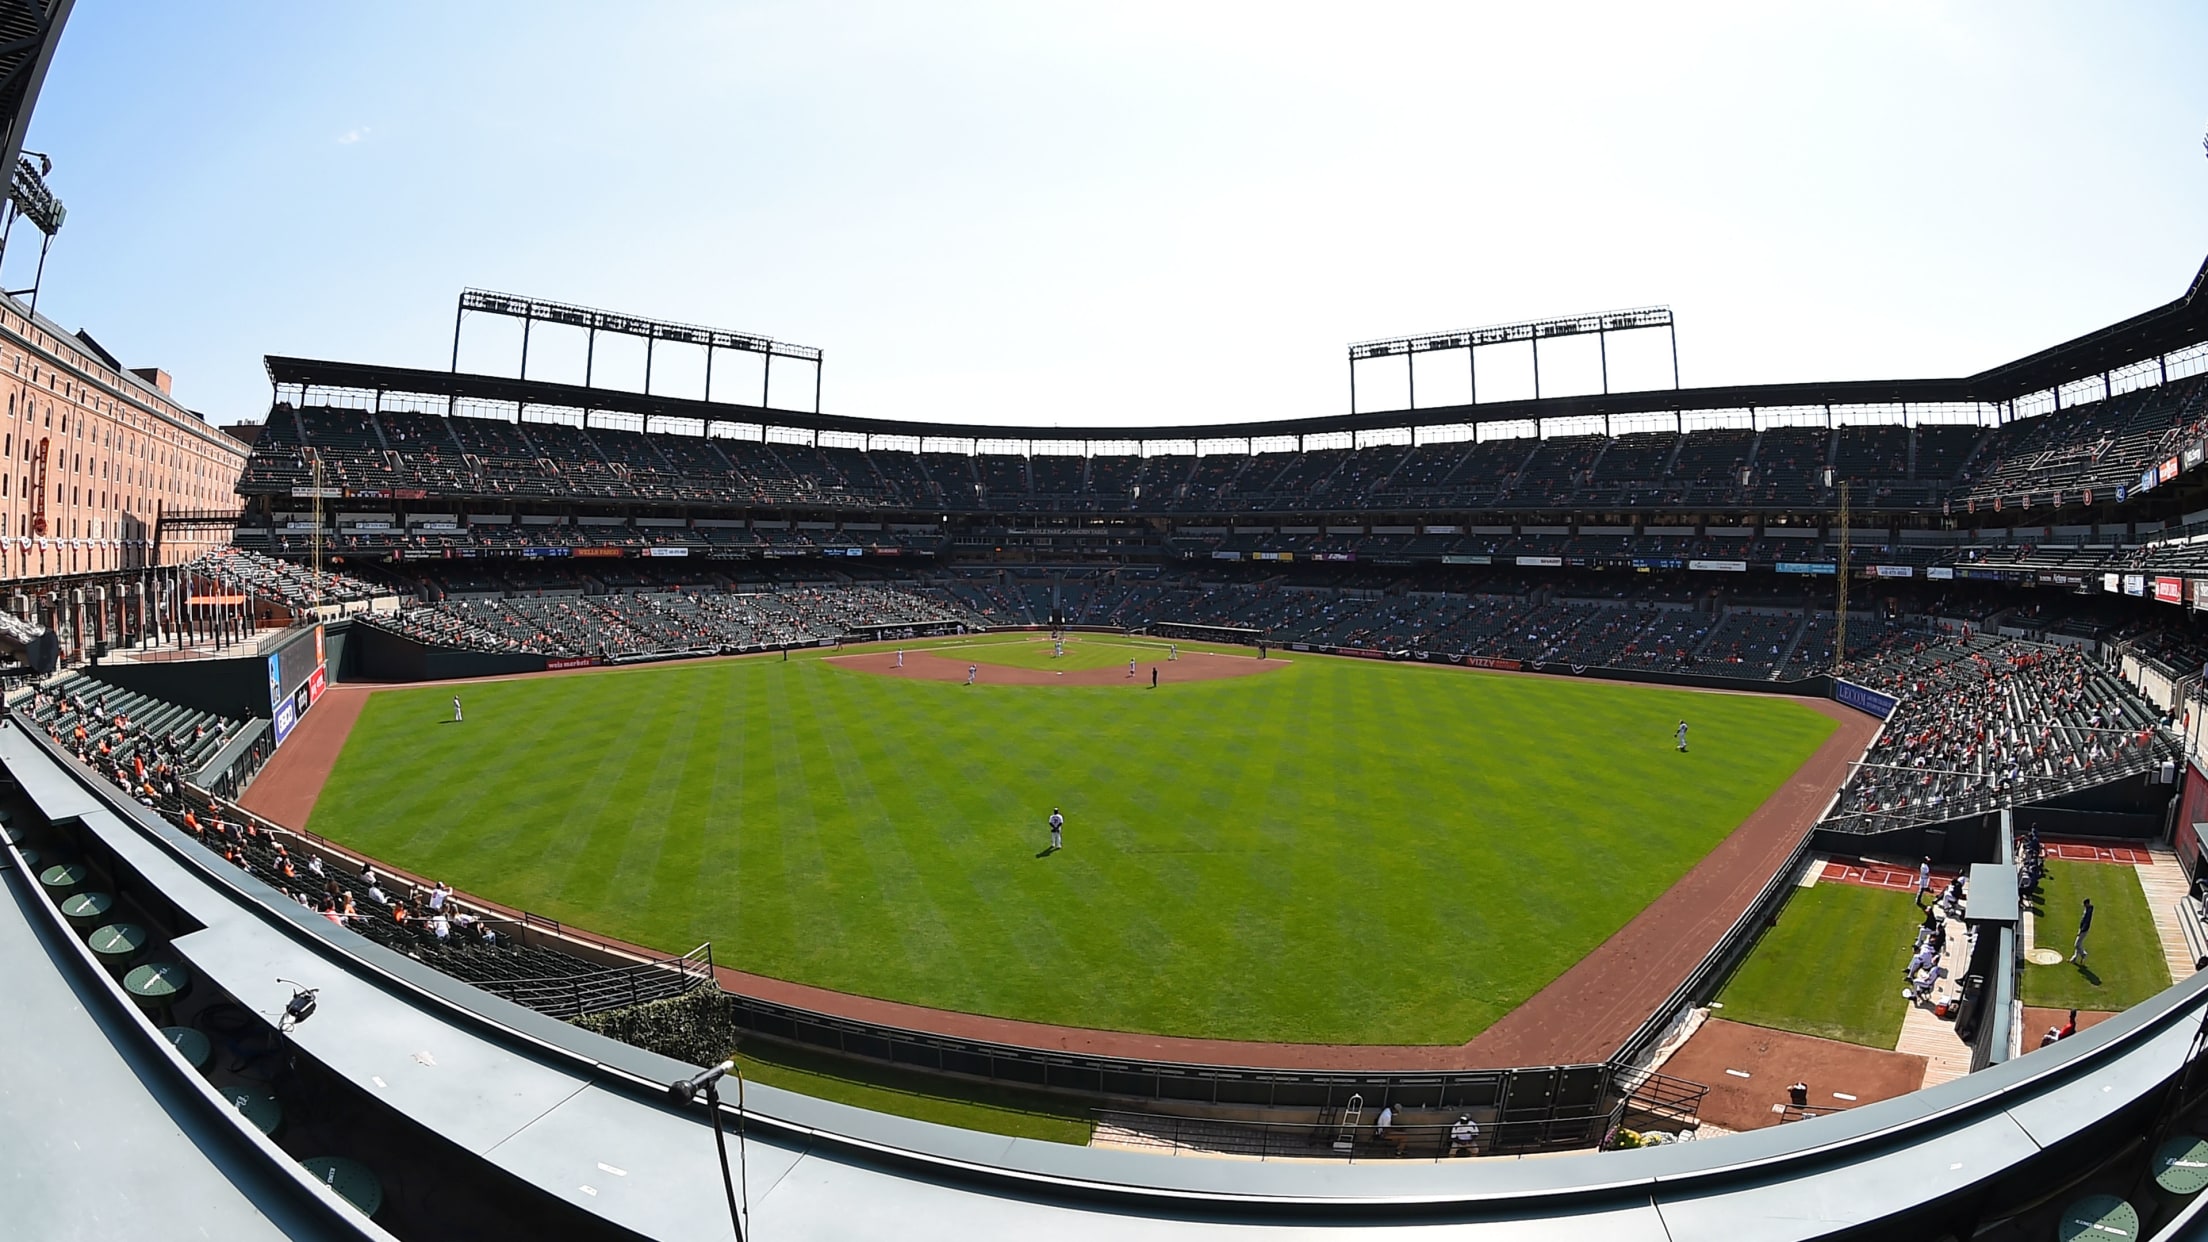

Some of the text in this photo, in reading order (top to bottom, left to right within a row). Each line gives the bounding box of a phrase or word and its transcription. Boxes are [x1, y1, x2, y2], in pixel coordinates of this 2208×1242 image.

[548, 659, 590, 669] weis markets
[1469, 657, 1495, 668] VIZZY
[1839, 684, 1867, 706] LECOM
